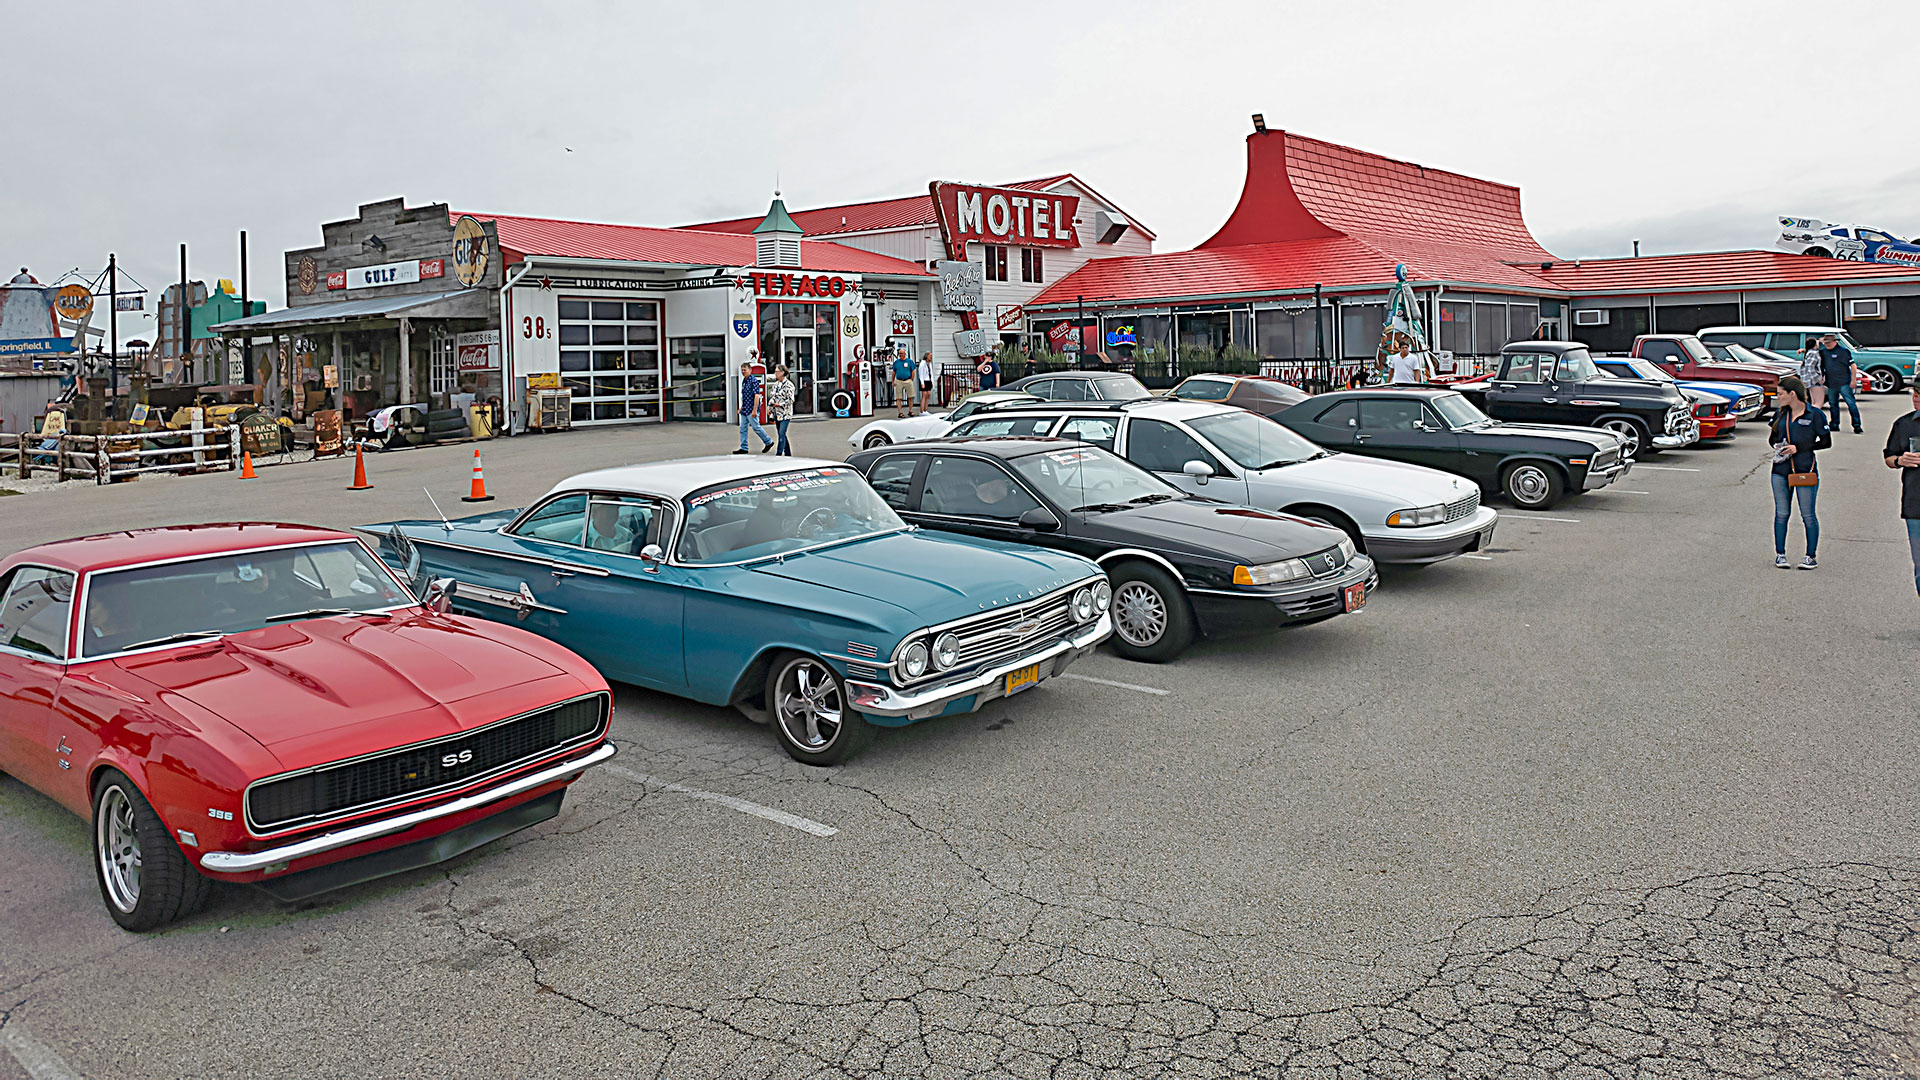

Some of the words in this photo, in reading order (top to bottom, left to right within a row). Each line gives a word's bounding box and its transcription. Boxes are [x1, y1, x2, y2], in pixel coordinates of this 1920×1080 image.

[957, 190, 1072, 240] MOTEL
[1796, 219, 1811, 229] LRS
[1836, 249, 1859, 261] 66
[1876, 245, 1920, 262] SUMMI
[364, 267, 397, 284] GULF
[576, 279, 647, 289] LUBRICATION
[748, 271, 846, 298] TEXACO
[60, 295, 91, 310] GULF
[949, 294, 976, 307] MANOR
[737, 323, 749, 334] 55
[846, 322, 858, 334] 66
[1050, 322, 1070, 339] ENTER
[968, 332, 981, 344] 80
[0, 341, 44, 353] pringfield,
[44, 341, 52, 349] IL
[243, 423, 278, 435] QUAKER
[691, 493, 727, 509] POWER
[727, 487, 751, 496] TOUR
[441, 749, 473, 767] SS
[208, 807, 233, 821] 396
